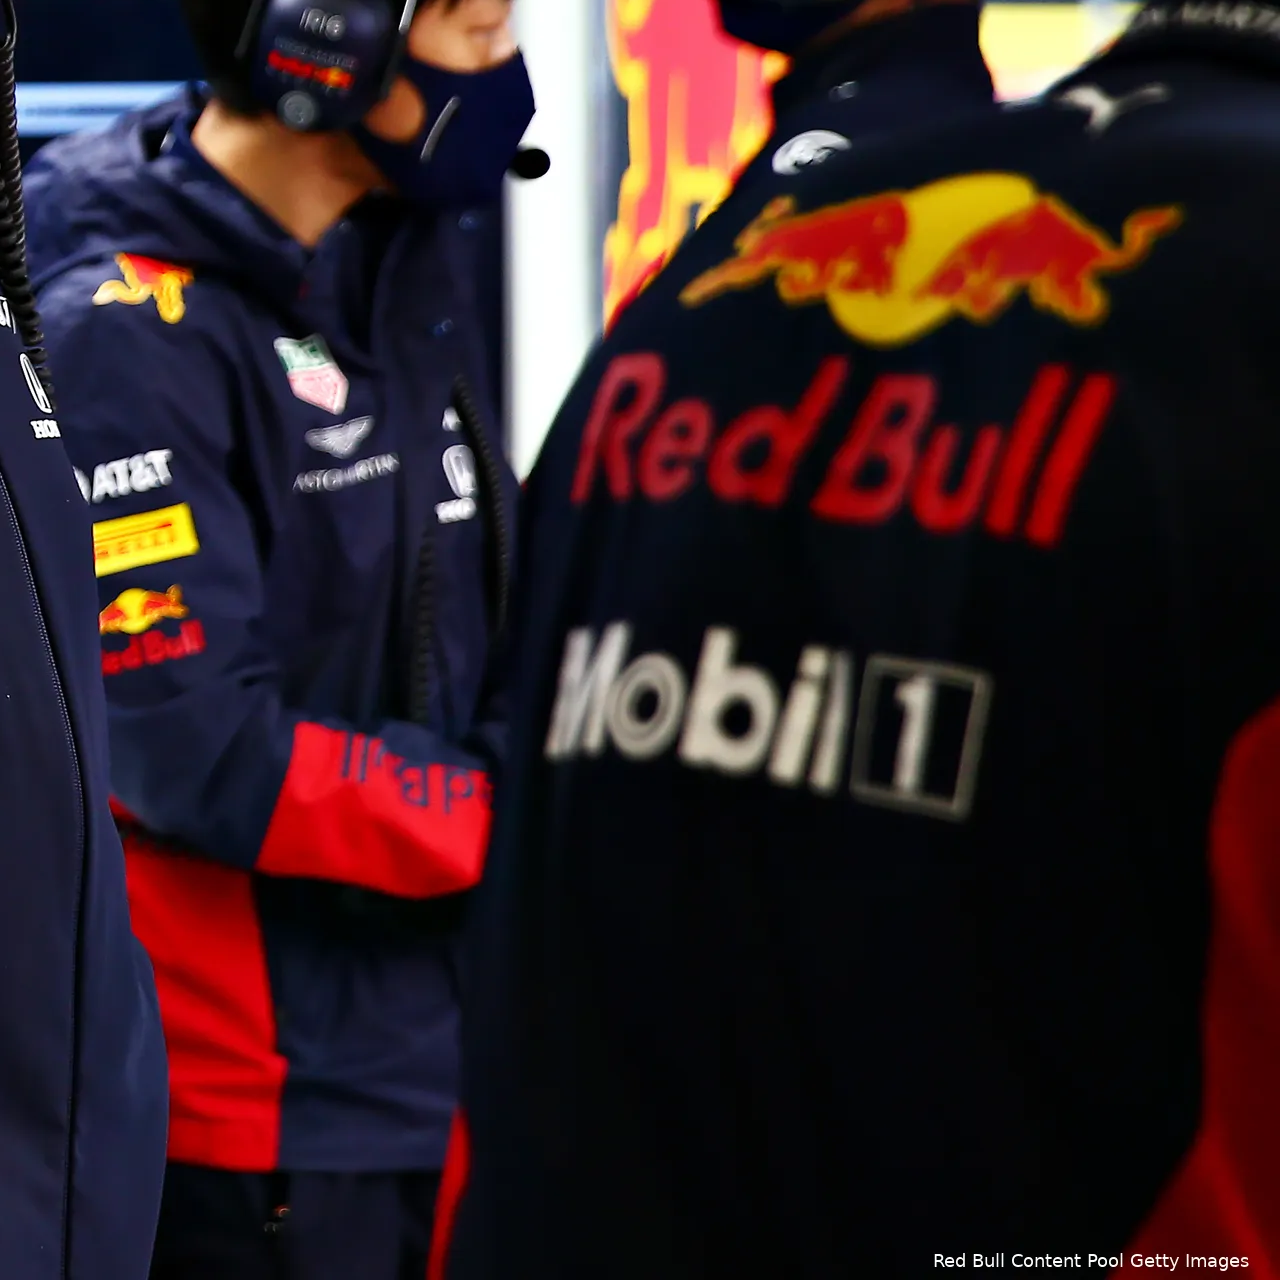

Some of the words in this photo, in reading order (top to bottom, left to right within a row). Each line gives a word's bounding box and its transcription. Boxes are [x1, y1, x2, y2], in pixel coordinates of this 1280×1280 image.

[92, 447, 174, 503] AT&T
[569, 351, 850, 505] Red
[810, 362, 1117, 549] Bull
[543, 622, 853, 797] Mobil
